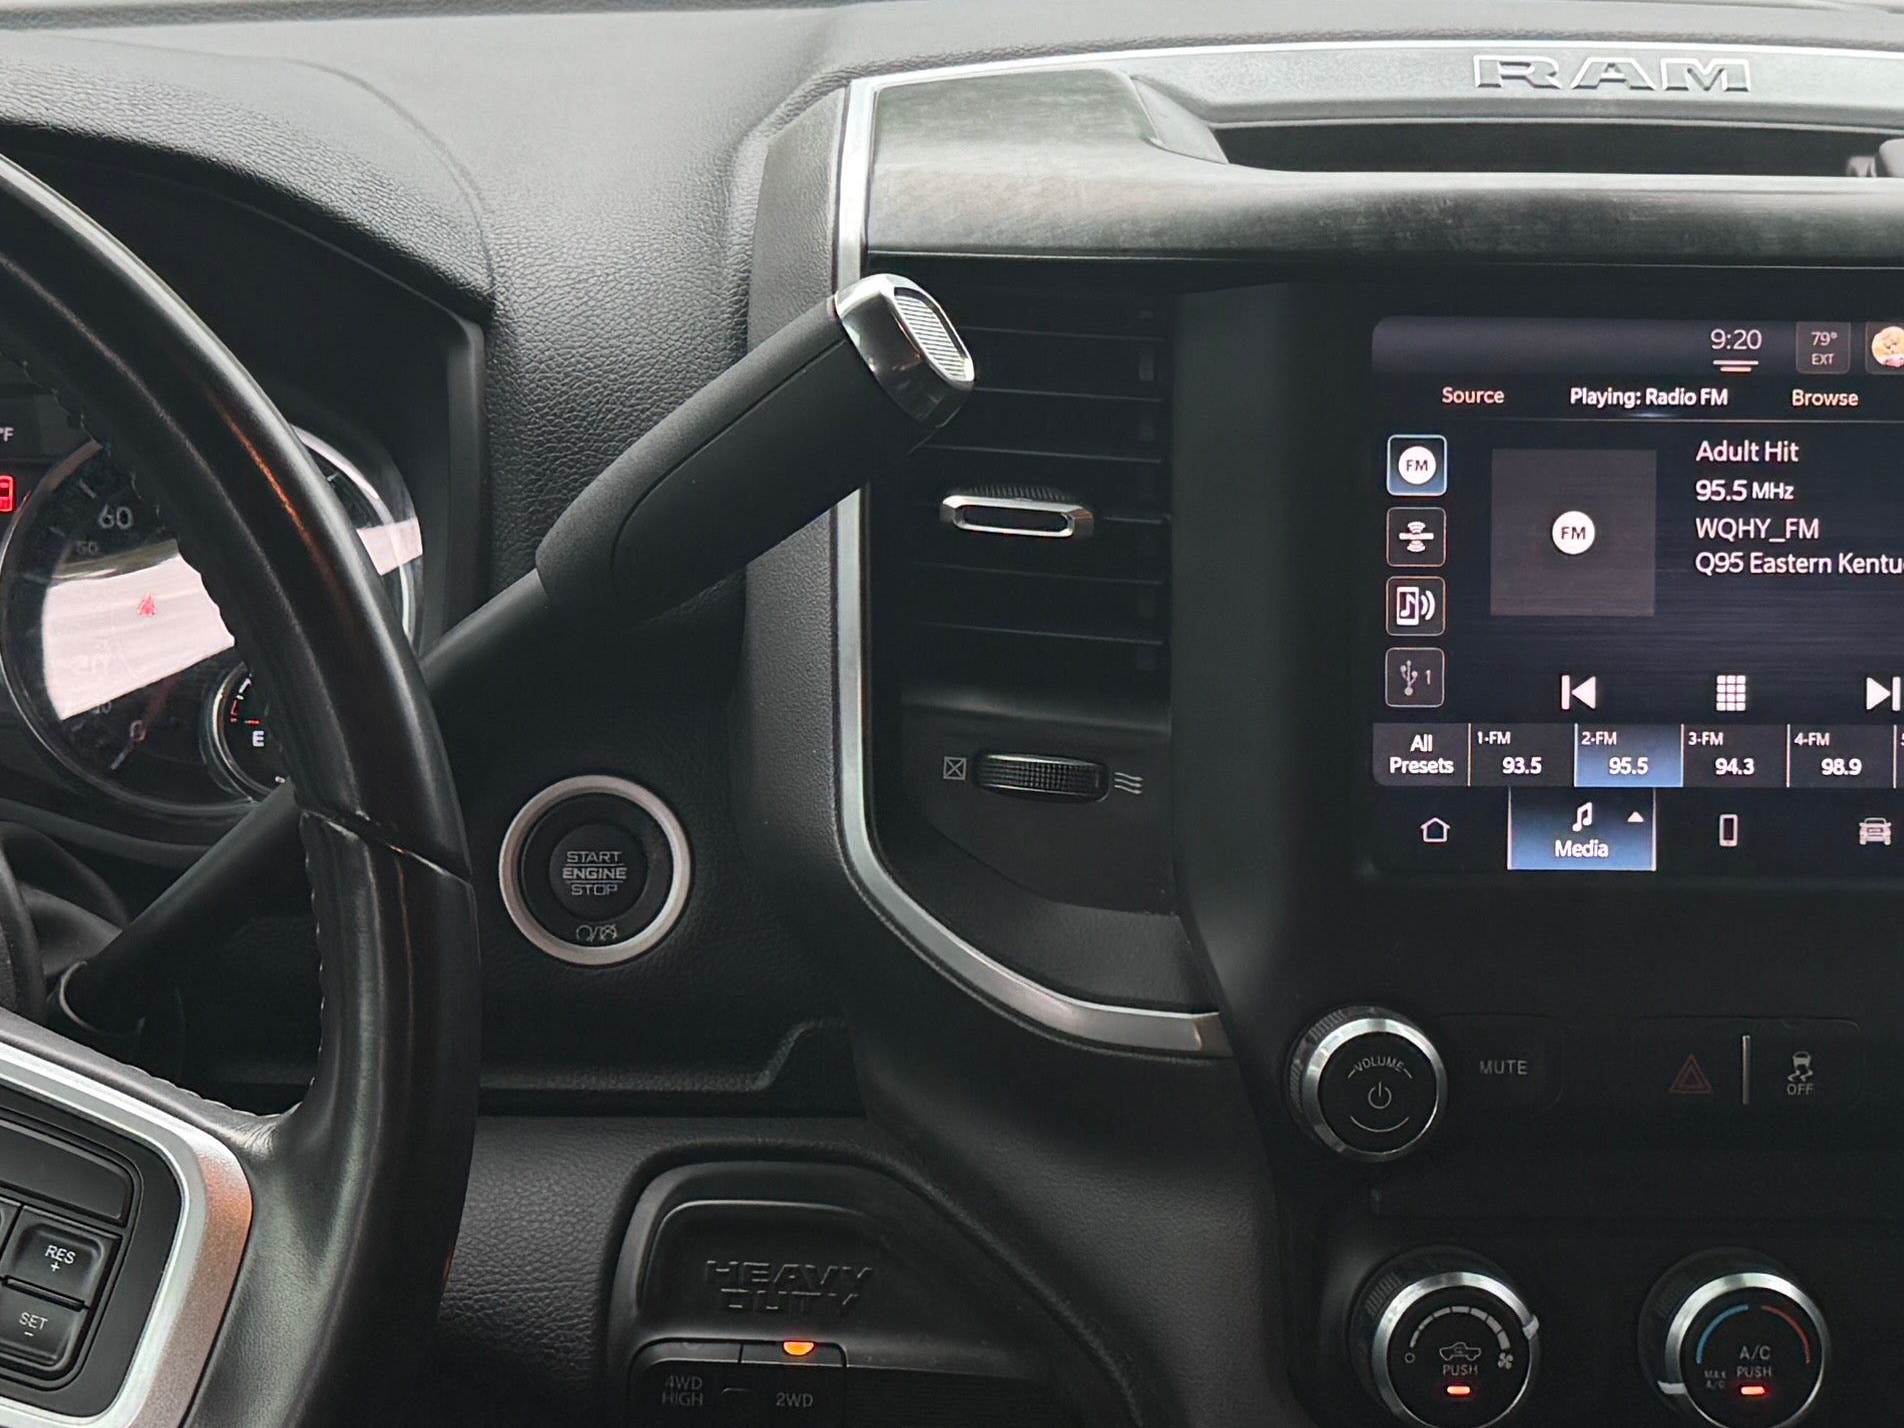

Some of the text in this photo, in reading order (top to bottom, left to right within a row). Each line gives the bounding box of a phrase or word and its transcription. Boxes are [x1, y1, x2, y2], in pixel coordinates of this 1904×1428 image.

[1472, 53, 1751, 92] RAM
[1710, 328, 1762, 350] 9:20
[1811, 331, 1838, 348] 79°
[1812, 352, 1834, 366] EXT
[1441, 387, 1505, 405] Source
[1570, 387, 1728, 408] Playing: Radio FM
[1791, 389, 1859, 407] Browse
[1696, 441, 1799, 463] Adult Hit
[1406, 458, 1428, 472] FM
[1696, 480, 1794, 501] 95.5 MHz
[99, 505, 134, 530] 60
[1561, 526, 1586, 540] FM
[1696, 518, 1819, 543] WQHY_FM
[1696, 553, 1744, 576] Q95
[1749, 553, 1832, 574] Eastern
[1424, 670, 1432, 684] 1
[252, 730, 265, 748] E
[1411, 735, 1433, 753] All
[1477, 731, 1511, 745] 1-FM
[1581, 732, 1617, 746] 2-FM
[1688, 732, 1724, 746] 3-FM
[1794, 732, 1830, 747] 4-FM
[1389, 757, 1454, 774] Presets
[1502, 757, 1542, 774] 93.5
[1609, 757, 1649, 775] 95.5
[1715, 758, 1755, 775] 94.3
[1821, 758, 1862, 775] 98.9
[566, 851, 622, 863] START
[1554, 839, 1608, 858] Media
[563, 867, 627, 880] ENGINE
[571, 884, 618, 896] STOP
[1354, 1056, 1405, 1073] VOLUME
[1480, 1060, 1528, 1075] MUTE
[1787, 1083, 1814, 1096] OFF
[44, 1243, 76, 1266] RES
[705, 1259, 873, 1286] HEAVY
[19, 1311, 48, 1333] SET
[1739, 1345, 1771, 1361] A/C
[1443, 1364, 1478, 1376] PUSH
[1736, 1366, 1773, 1378] PUSH
[665, 1375, 703, 1390] 4WD
[662, 1392, 704, 1407] HIGH
[776, 1393, 814, 1408] 2WD
